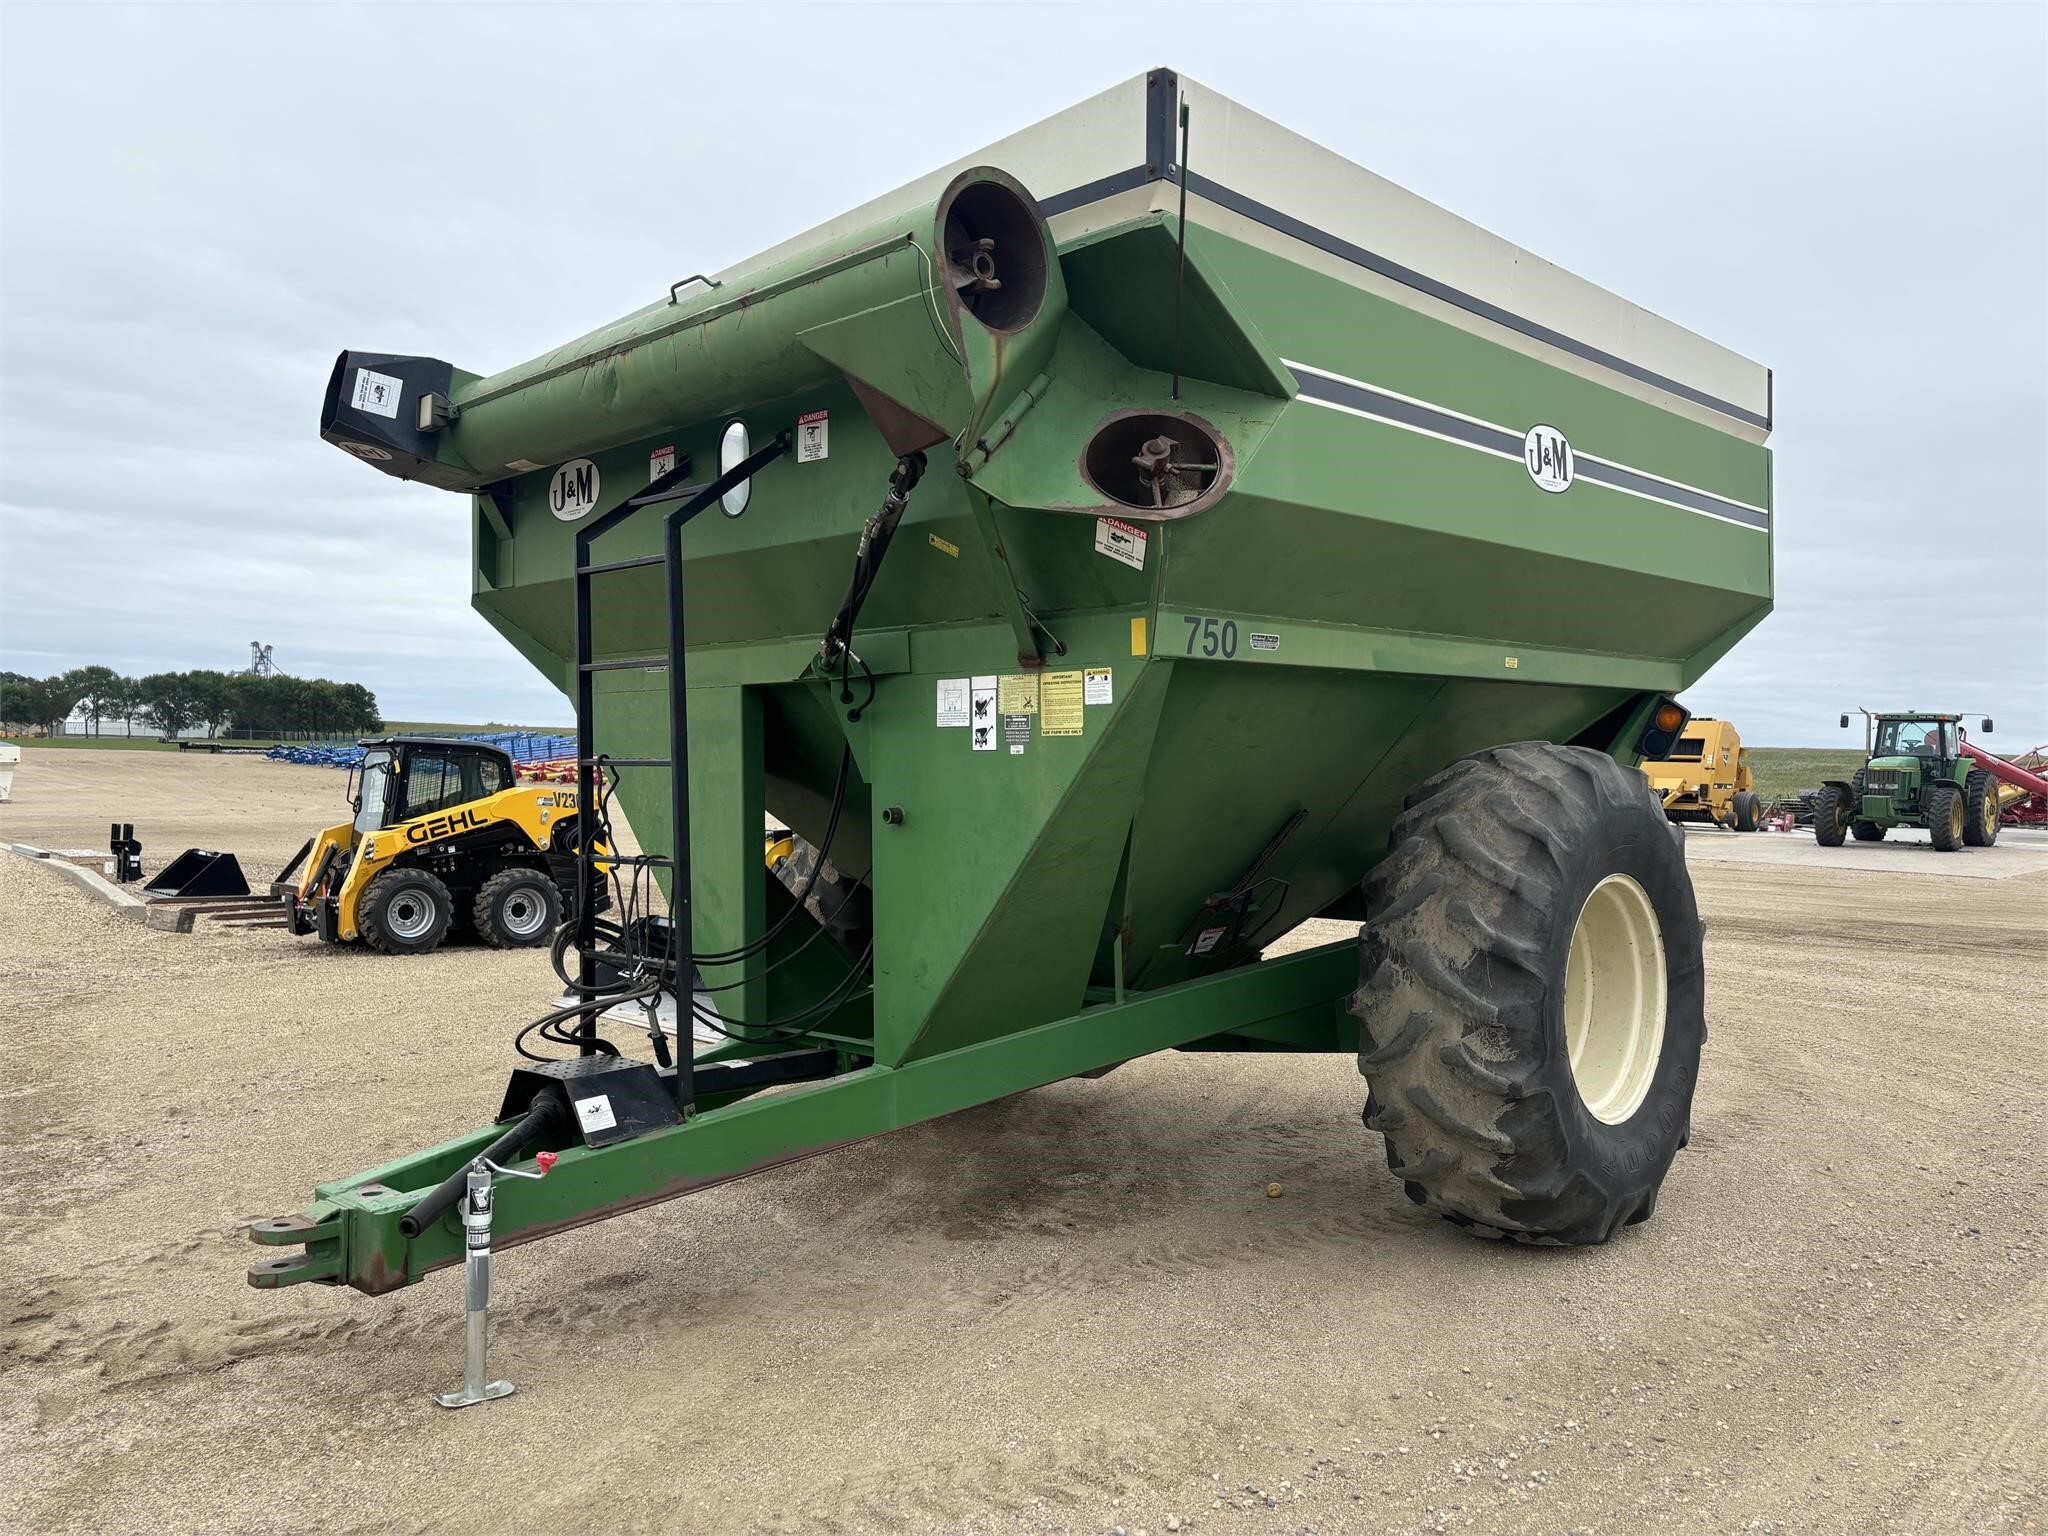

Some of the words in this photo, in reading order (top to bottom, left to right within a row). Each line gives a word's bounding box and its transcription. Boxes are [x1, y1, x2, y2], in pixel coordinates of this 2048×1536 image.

[803, 410, 828, 422] DANGER
[655, 445, 674, 457] DANGER
[1528, 432, 1568, 482] J&M
[552, 464, 593, 511] J&M
[1107, 518, 1147, 540] DANGER
[1184, 616, 1238, 659] 750
[553, 791, 580, 809] V23
[406, 810, 489, 844] GEHL
